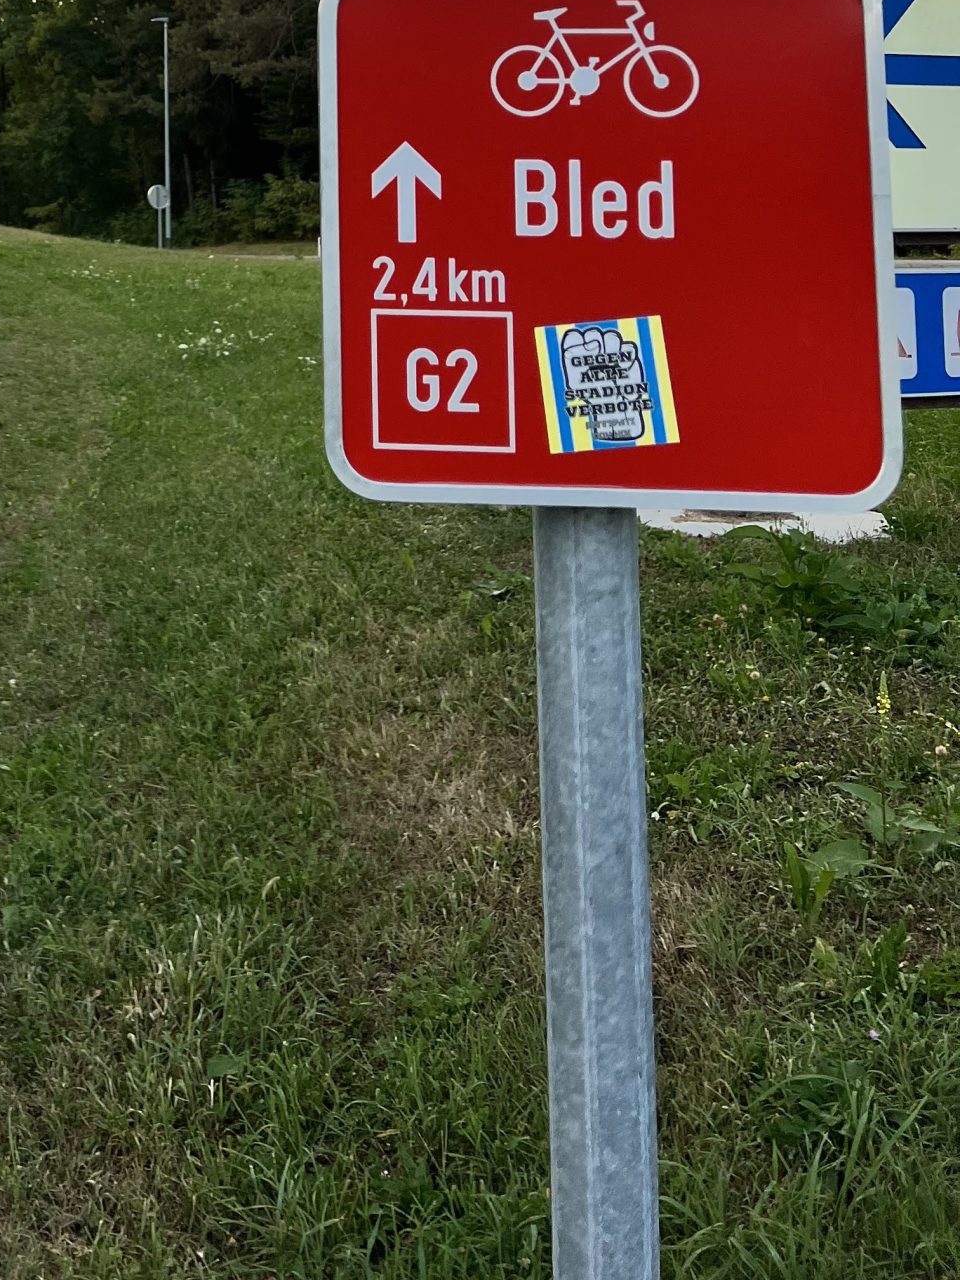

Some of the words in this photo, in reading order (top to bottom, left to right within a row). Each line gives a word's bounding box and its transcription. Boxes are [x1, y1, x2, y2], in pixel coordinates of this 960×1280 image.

[514, 159, 675, 239] Bled
[372, 256, 438, 307] 2,4
[448, 257, 506, 303] km
[571, 351, 633, 367] GEGEN
[406, 347, 480, 413] G2
[580, 368, 629, 383] ALLE
[564, 382, 649, 401] STADION
[565, 399, 653, 417] VERBOTE
